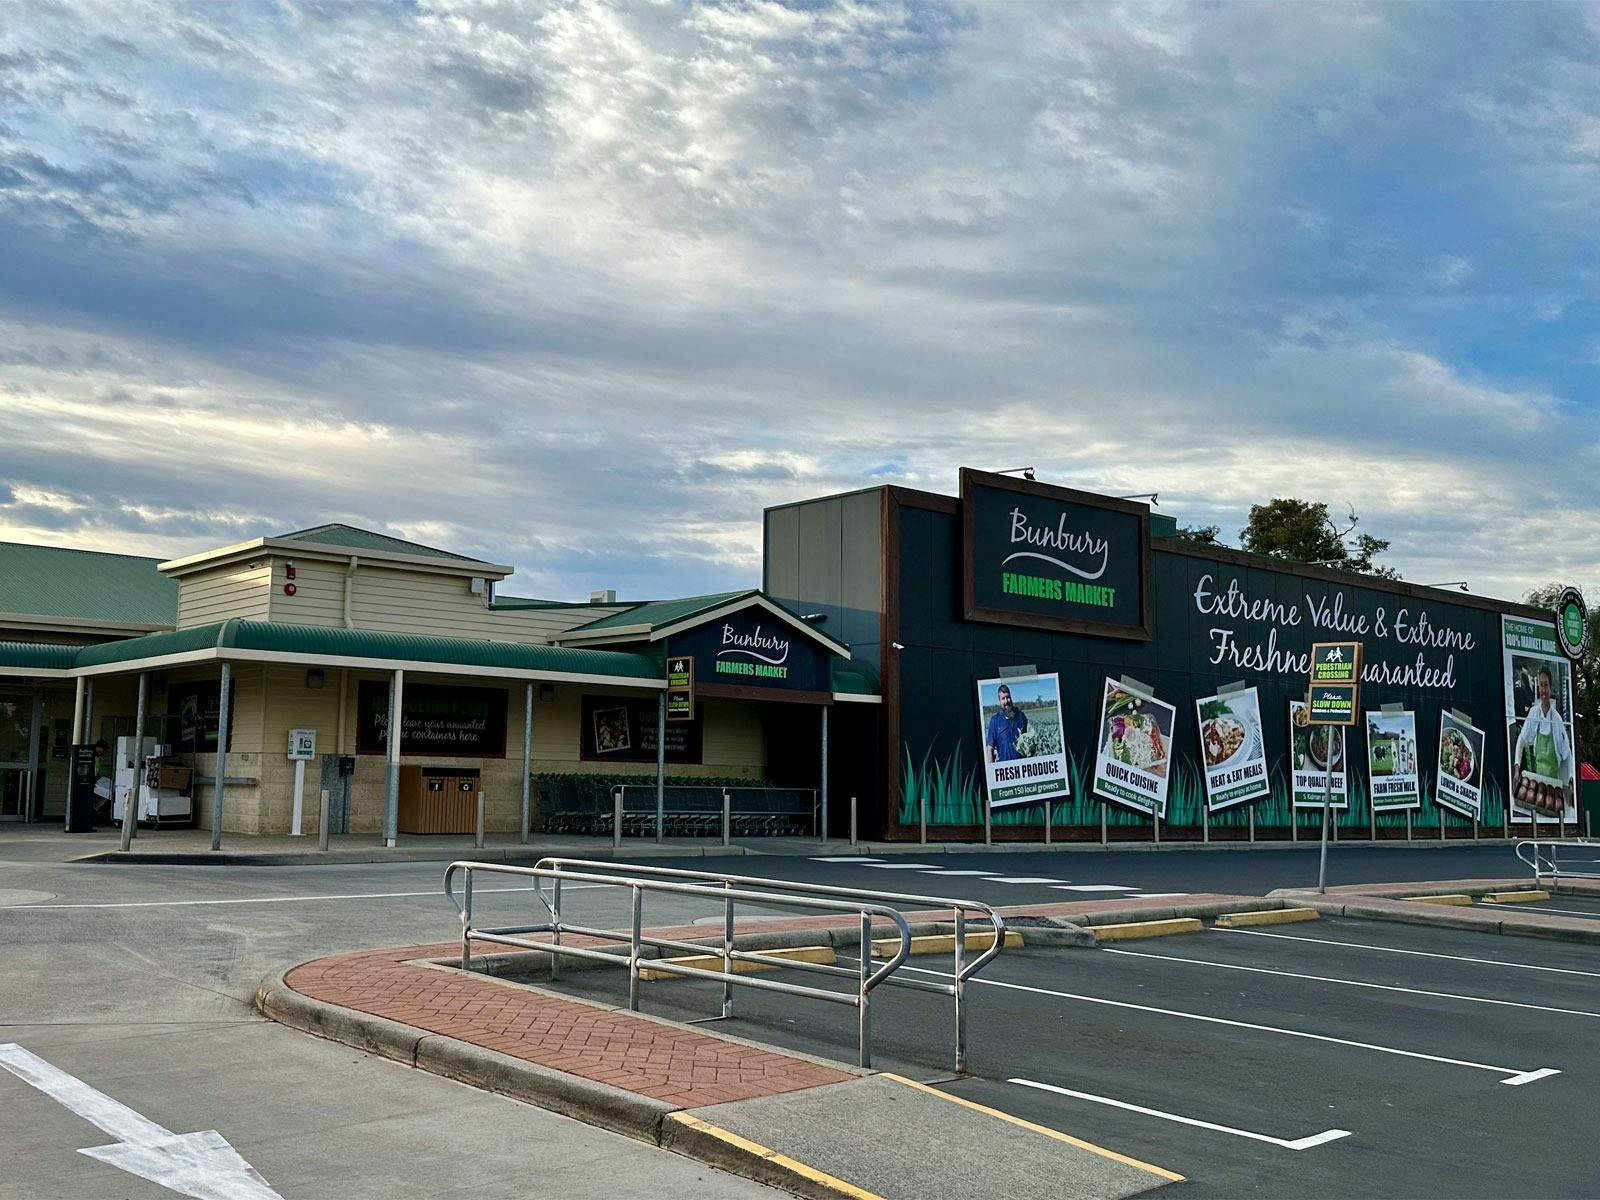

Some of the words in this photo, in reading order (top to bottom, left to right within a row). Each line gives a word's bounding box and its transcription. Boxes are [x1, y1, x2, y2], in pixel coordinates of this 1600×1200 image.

[1008, 507, 1108, 568] Bunbury
[1002, 572, 1062, 600] FARMERS
[1065, 582, 1115, 608] MARKET
[1193, 574, 1302, 626] Extreme
[1305, 591, 1370, 635] Value
[1374, 607, 1388, 638] &
[1394, 608, 1476, 651] Extreme
[720, 623, 789, 657] Bunbury
[1209, 627, 1312, 674] Freshne
[1360, 652, 1457, 689] uaranteed
[1316, 662, 1352, 671] PEDESTRIAN
[715, 661, 754, 676] FARMERS
[755, 664, 788, 679] MARKET
[1318, 671, 1349, 679] CROSSING
[1312, 700, 1330, 708] SLOW
[1331, 700, 1351, 709] DOWN
[1322, 692, 1342, 700] Please
[424, 719, 445, 732] your
[446, 718, 487, 731] unwanted
[411, 728, 456, 741] containers
[995, 766, 1020, 782] FRESH
[1021, 760, 1059, 778] PRODUCE
[1106, 762, 1129, 783] QUICK
[1129, 772, 1159, 794] CUISINE
[1210, 773, 1226, 789] HEAT
[1226, 773, 1232, 784] &
[1231, 768, 1243, 783] EAT
[1243, 763, 1263, 779] MEALS
[998, 788, 1014, 798] From
[1014, 786, 1024, 795] 150
[1024, 784, 1038, 793] local
[1037, 782, 1059, 793] growers
[1104, 782, 1119, 795] Ready
[1119, 788, 1126, 796] to
[1125, 791, 1137, 800] cook
[1296, 775, 1307, 787] TOP
[1308, 776, 1327, 788] QUALIT
[1330, 777, 1343, 789] BEEF
[1373, 783, 1387, 794] FARM
[1388, 782, 1403, 793] FRESH
[1403, 781, 1416, 792] MILK
[1440, 776, 1456, 792] LUNCH
[1459, 785, 1478, 802] SNACKS
